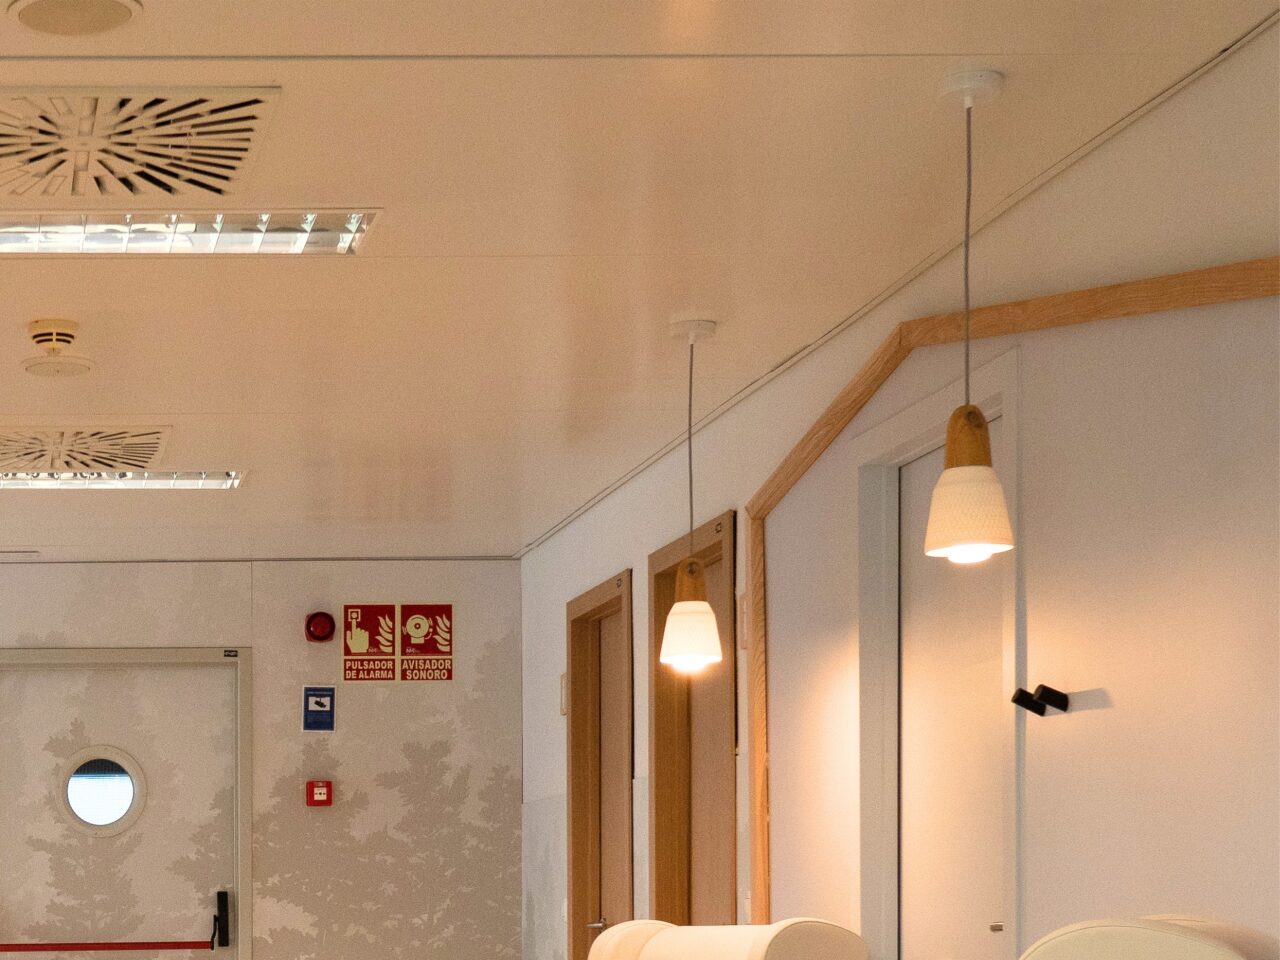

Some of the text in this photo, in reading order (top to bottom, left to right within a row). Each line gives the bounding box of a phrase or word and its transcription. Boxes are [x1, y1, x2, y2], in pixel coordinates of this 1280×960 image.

[345, 661, 393, 669] PULSADOR
[402, 660, 451, 669] AVISADOR
[346, 670, 393, 679] DE ALARMA
[406, 670, 448, 679] SONORO
